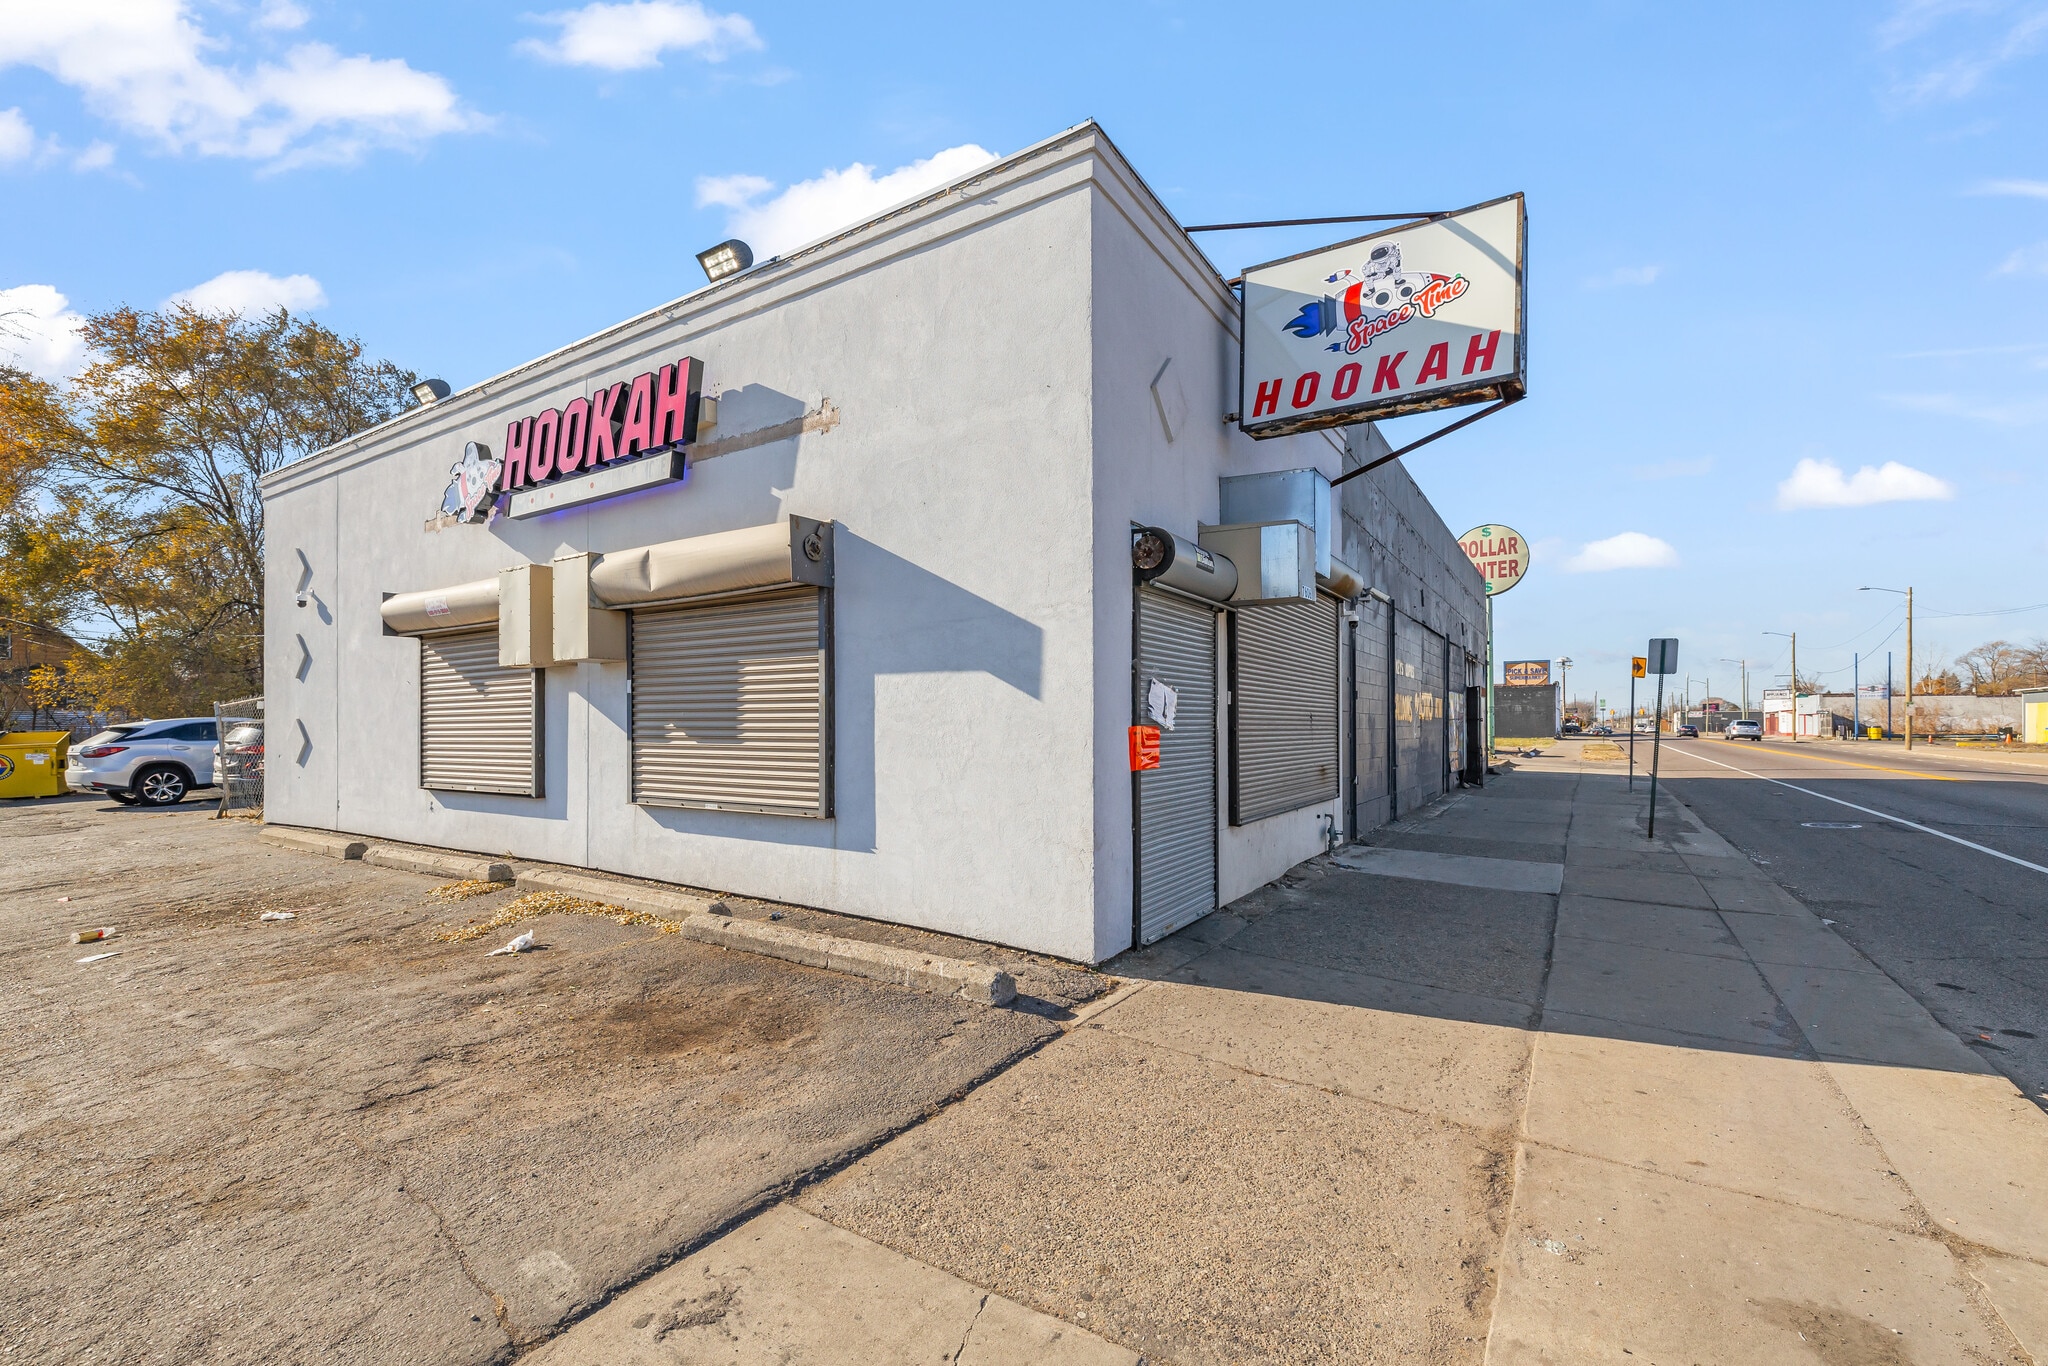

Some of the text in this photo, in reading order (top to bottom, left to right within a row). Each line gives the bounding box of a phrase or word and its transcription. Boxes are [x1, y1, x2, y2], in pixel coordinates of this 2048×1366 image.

[1346, 277, 1467, 353] Space Time
[1252, 330, 1501, 418] HOOKAH
[502, 356, 694, 491] HOOKAH
[1475, 559, 1519, 578] NTER
